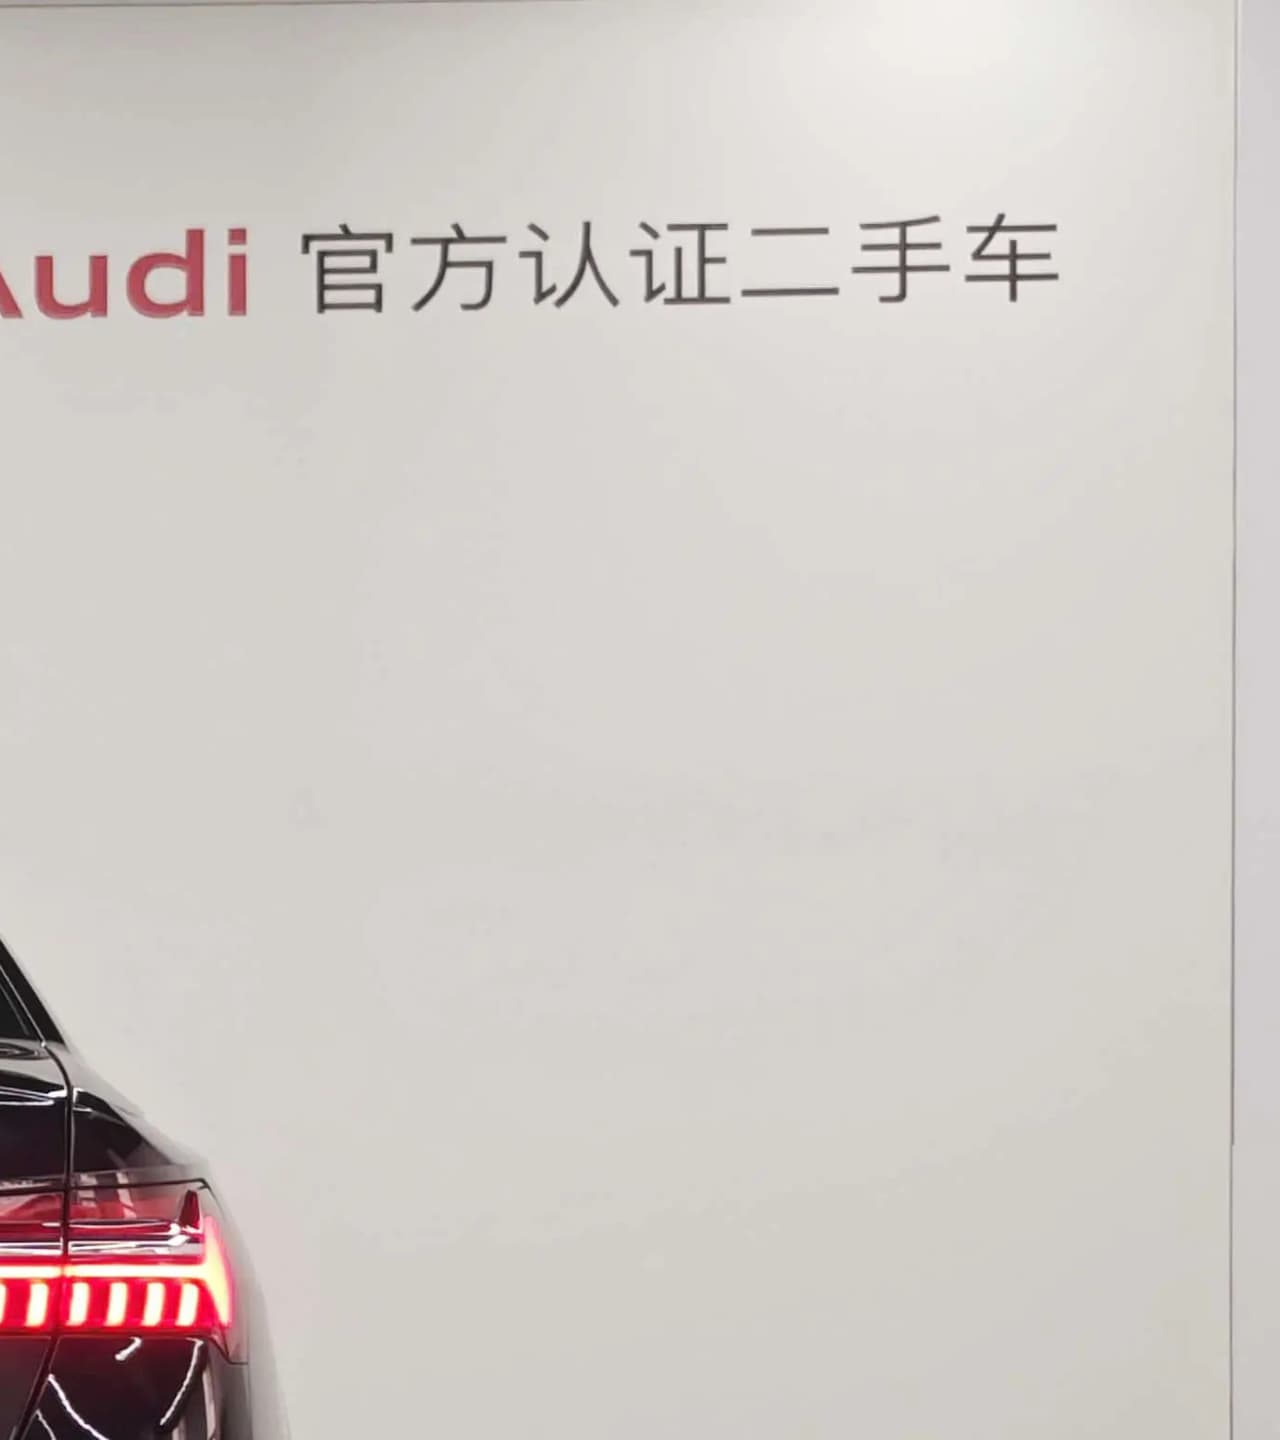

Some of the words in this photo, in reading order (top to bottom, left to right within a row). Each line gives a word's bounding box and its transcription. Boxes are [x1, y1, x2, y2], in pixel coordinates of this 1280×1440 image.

[300, 213, 1059, 314] 官方认证二手车
